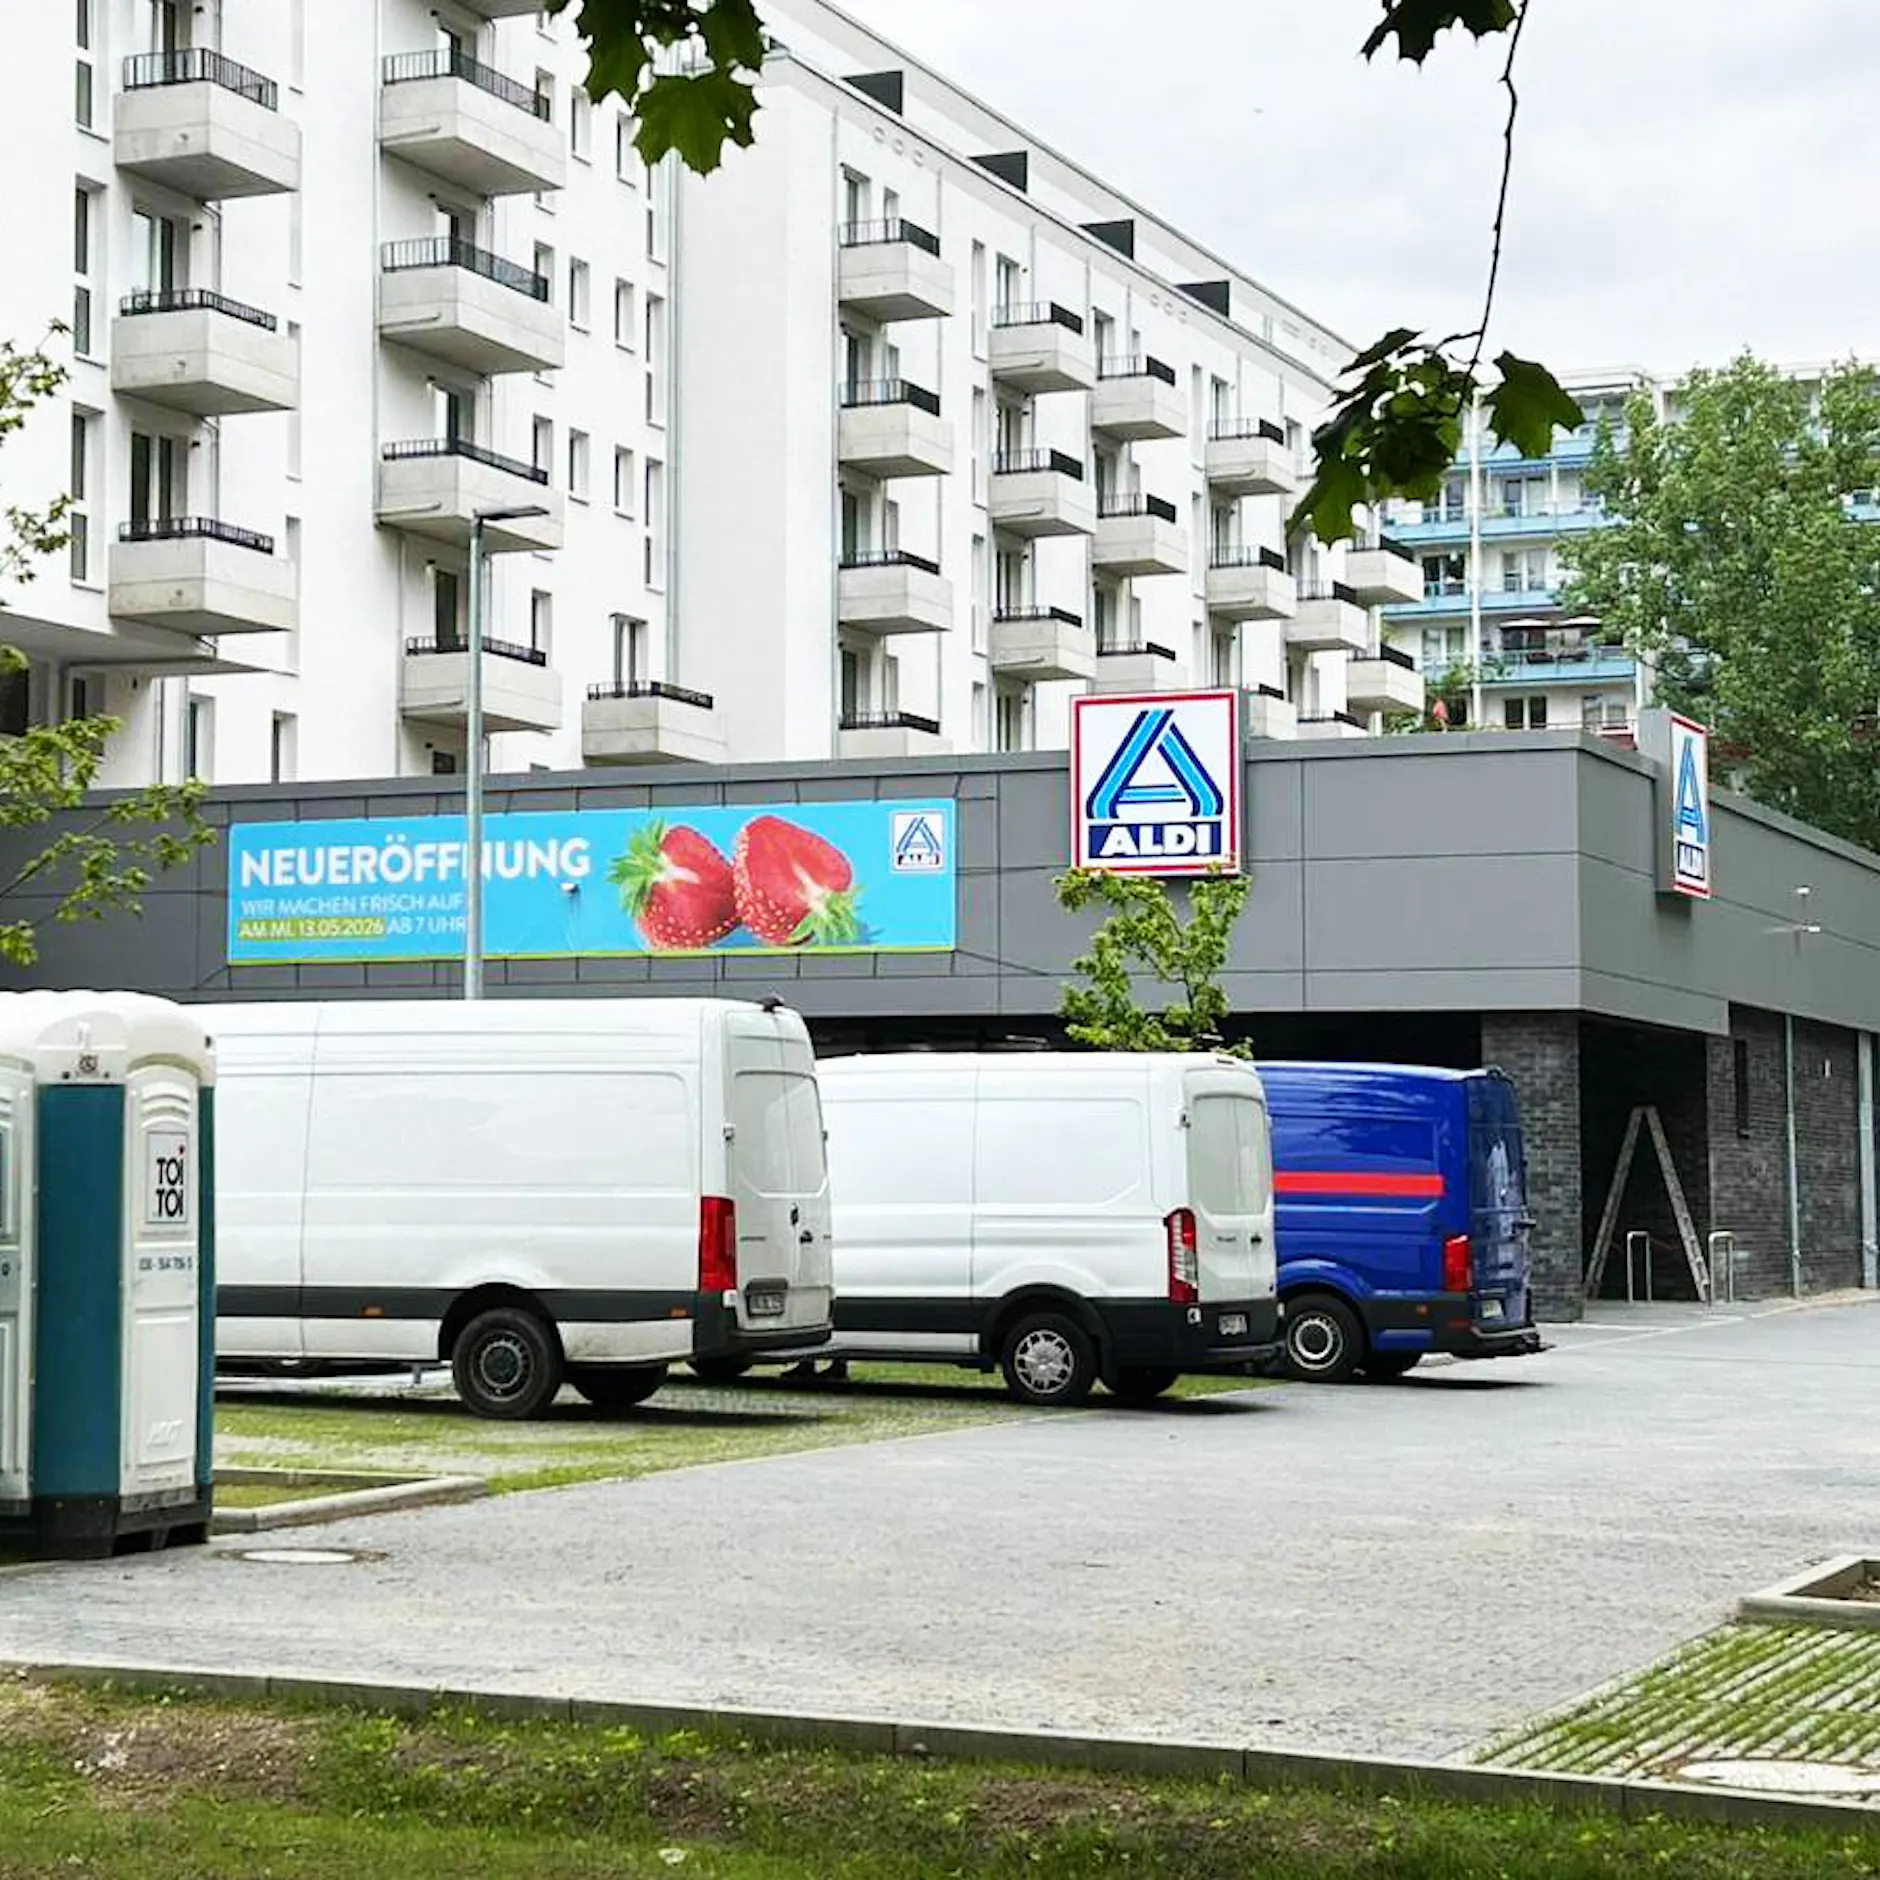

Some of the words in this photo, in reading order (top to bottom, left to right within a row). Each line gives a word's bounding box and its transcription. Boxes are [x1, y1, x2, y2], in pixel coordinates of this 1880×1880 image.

[1100, 823, 1211, 856] ALDI
[241, 834, 591, 887] NEUERÖFFNUNG
[241, 898, 274, 916] WIR
[278, 895, 357, 916] MACHEN
[360, 892, 424, 913] FRISCH
[427, 891, 464, 911] AUF
[239, 920, 267, 938] AM
[298, 916, 385, 936] 13.05.2026
[386, 915, 412, 935] AB
[416, 915, 425, 934] 7
[427, 914, 467, 935] UHR
[156, 1188, 184, 1217] TOI
